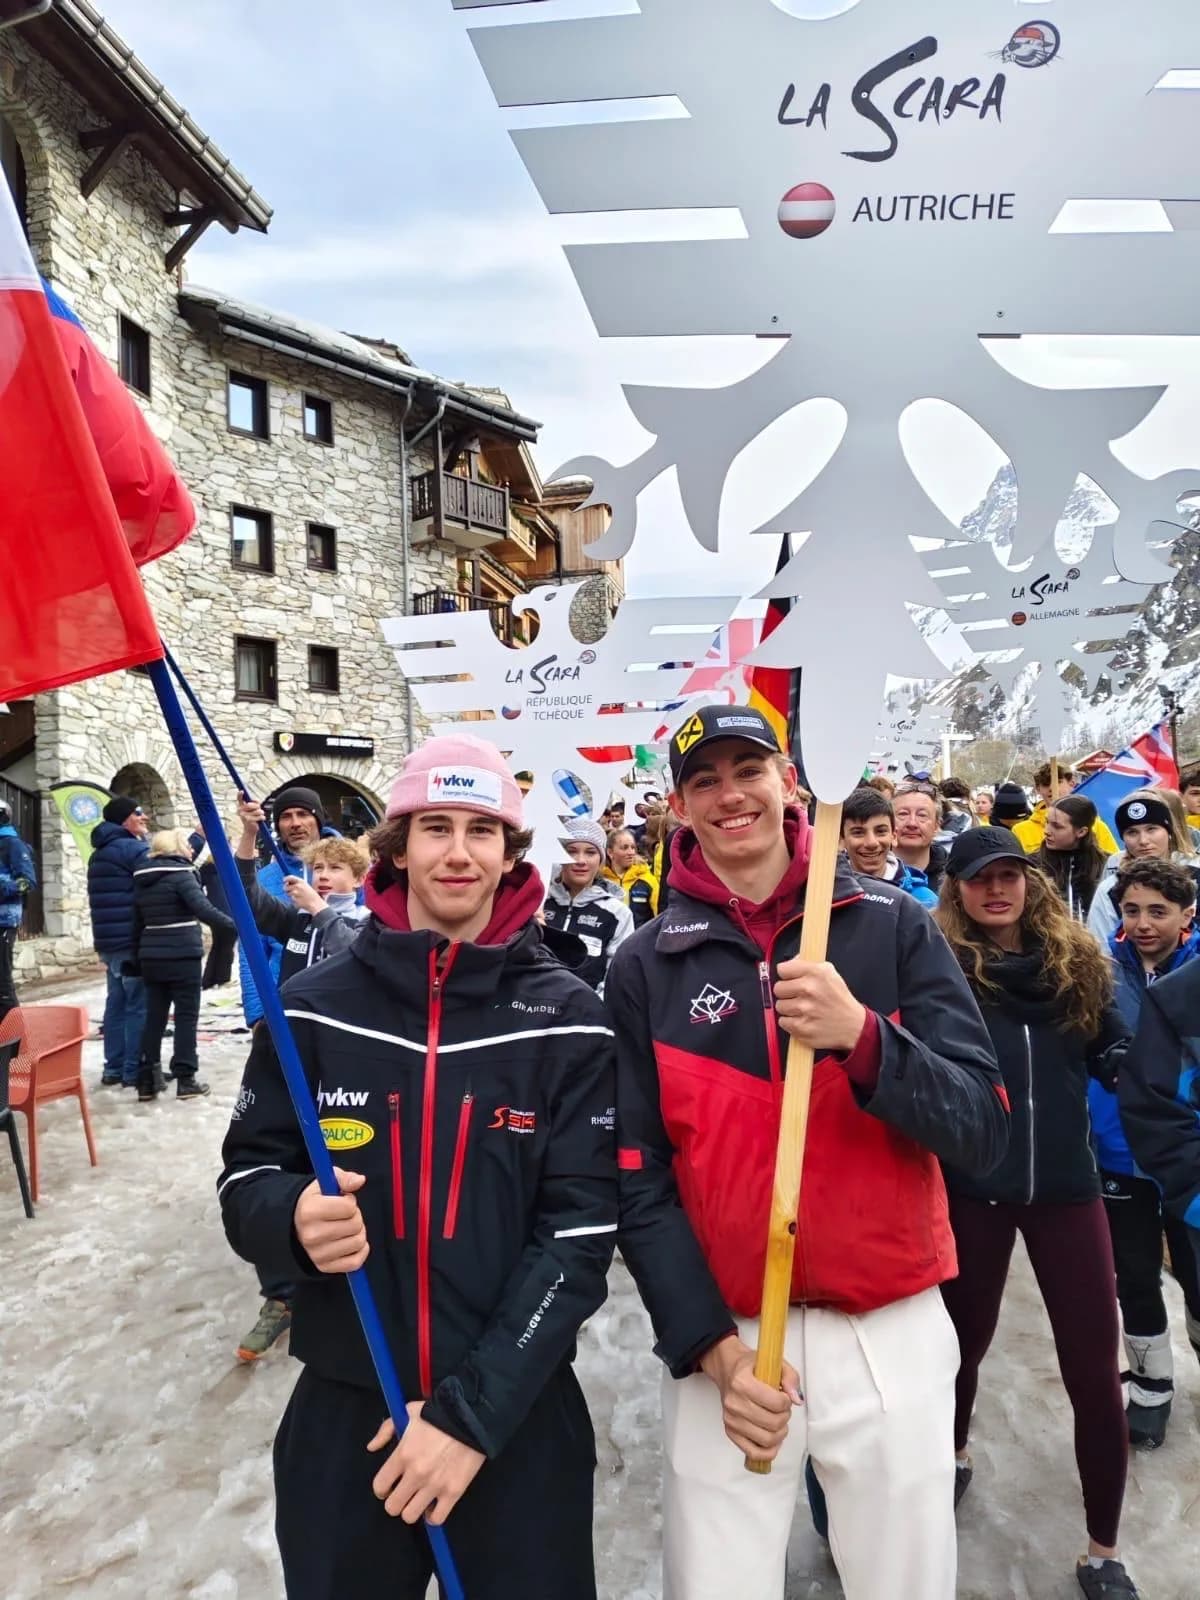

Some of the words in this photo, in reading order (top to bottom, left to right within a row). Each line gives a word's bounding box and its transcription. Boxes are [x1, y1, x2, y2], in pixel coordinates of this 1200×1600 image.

[778, 83, 831, 131] LA
[840, 36, 1006, 162] SCARA
[852, 193, 1016, 222] AUTRICHE
[1011, 586, 1025, 598] LA
[1029, 573, 1069, 605] SCARA
[1030, 608, 1080, 620] ALLEMAGNE
[505, 669, 523, 683] LA
[528, 654, 581, 694] SCARA
[443, 774, 475, 788] vkw
[674, 921, 709, 933] Schöffel
[324, 1087, 369, 1106] vkw
[516, 1290, 555, 1349] GIRARDELLI
